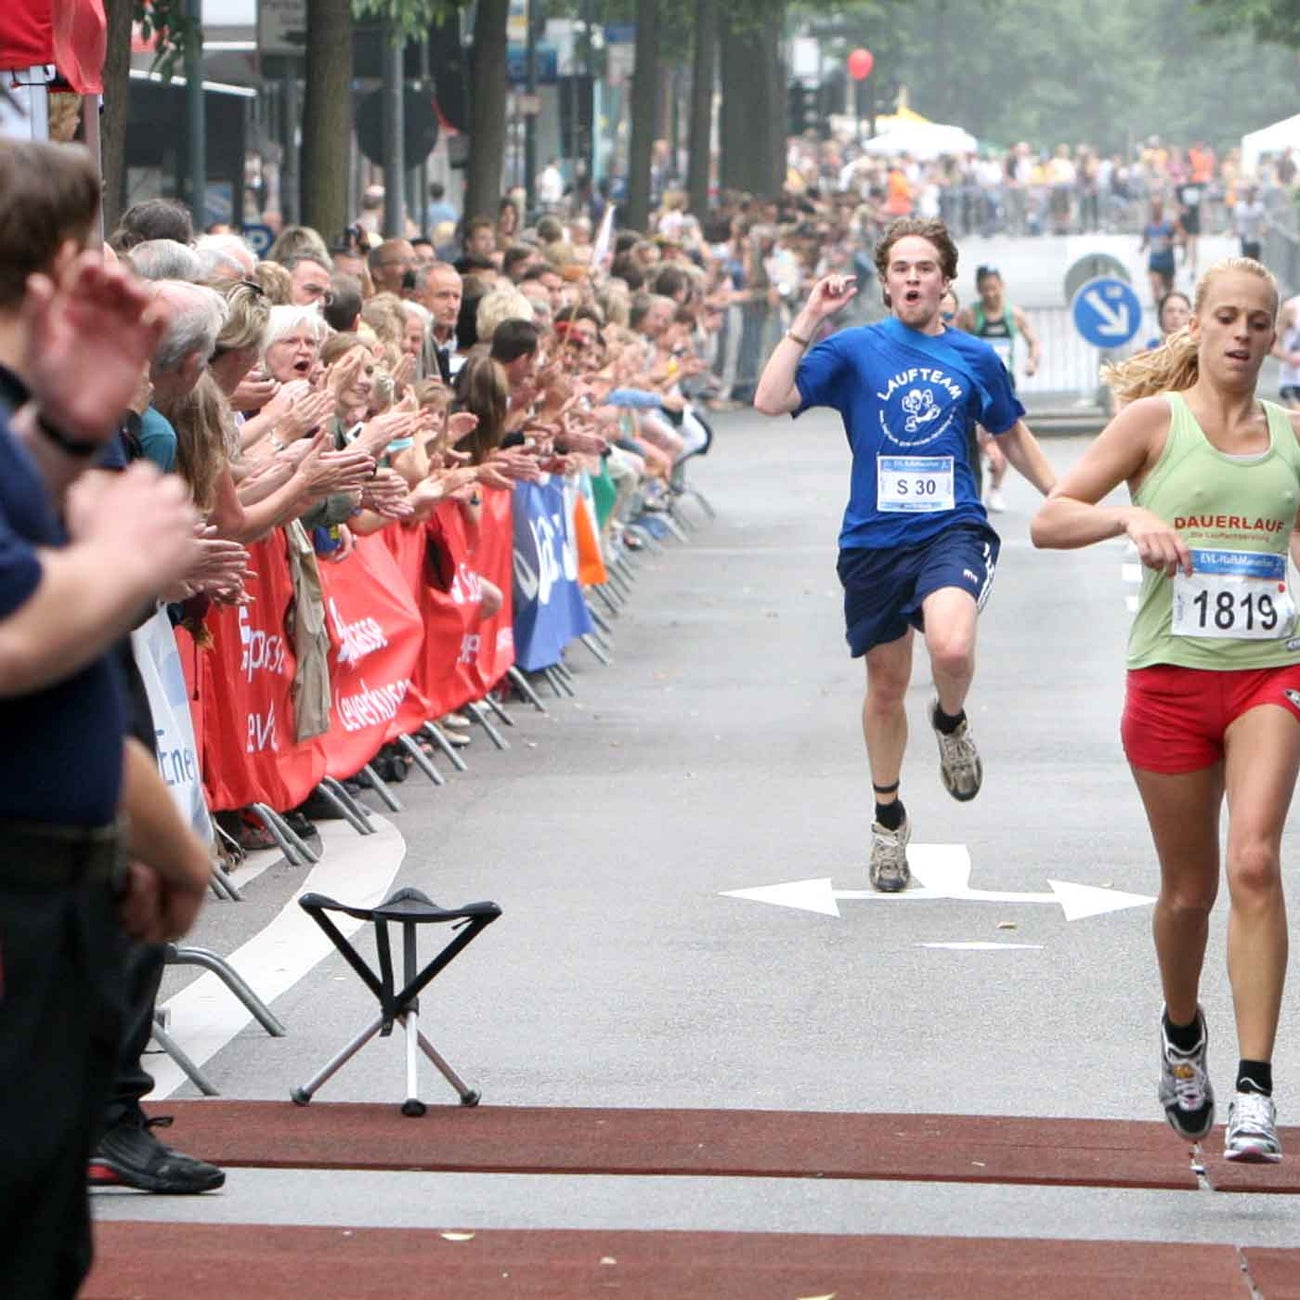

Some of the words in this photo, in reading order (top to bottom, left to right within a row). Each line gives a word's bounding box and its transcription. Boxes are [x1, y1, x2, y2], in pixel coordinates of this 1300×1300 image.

[876, 368, 963, 401] LAUFTEAM
[897, 479, 909, 495] S
[915, 479, 937, 496] 30
[1174, 515, 1286, 533] DAUERLAUF
[1193, 589, 1278, 631] 1819
